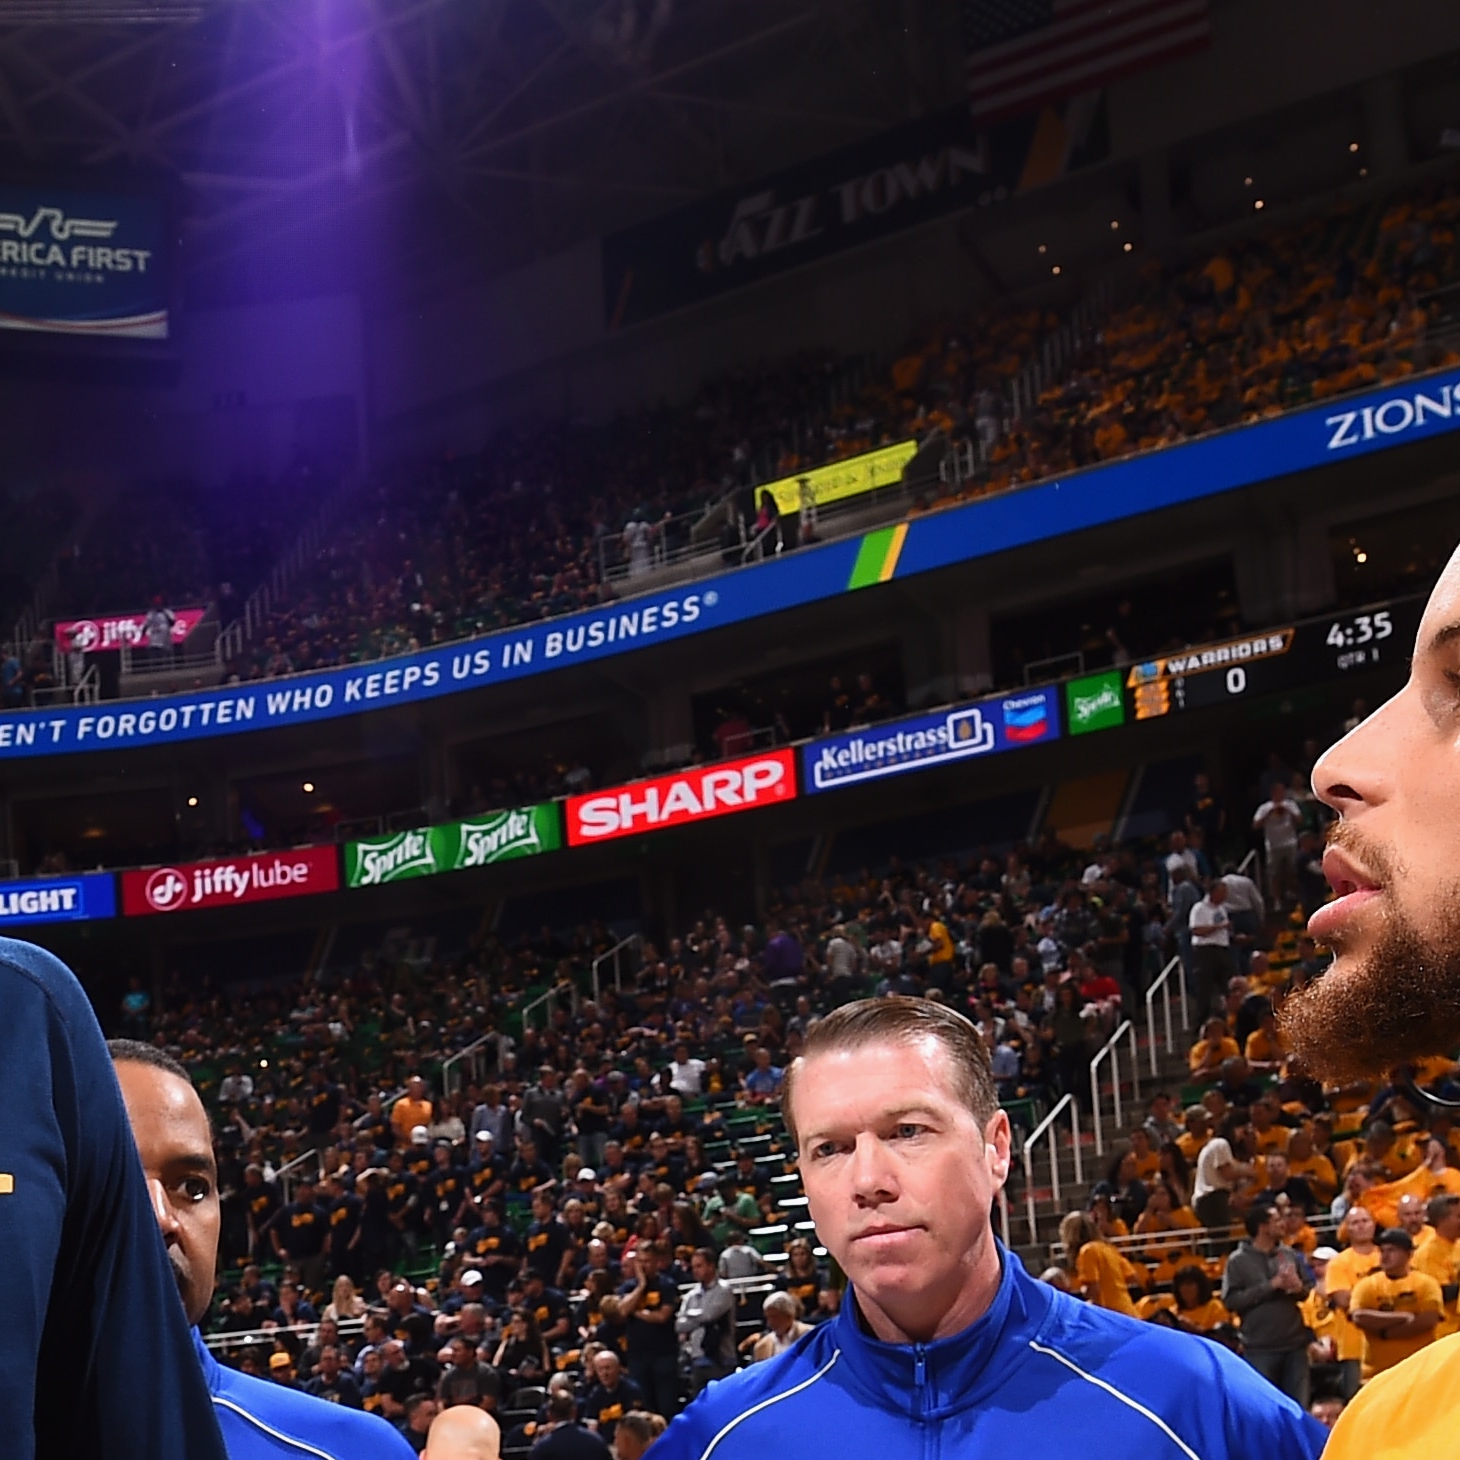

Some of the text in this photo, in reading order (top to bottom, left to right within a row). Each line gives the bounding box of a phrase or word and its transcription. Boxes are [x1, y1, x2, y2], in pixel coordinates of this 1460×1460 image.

[829, 135, 991, 225] TOWN
[70, 245, 152, 274] FIRST
[1167, 634, 1284, 676] WARRIORS
[1326, 611, 1393, 648] 4:35
[76, 695, 256, 742] FORGOTTEN
[266, 684, 334, 716] WHO
[344, 660, 441, 704] KEEPS
[452, 648, 491, 682] US
[502, 639, 535, 669] IN
[1226, 666, 1247, 694] 0
[821, 724, 949, 770] Kellerstrass
[578, 760, 785, 838] SHARP
[362, 828, 426, 887] Sprite
[463, 810, 530, 867] Sprite
